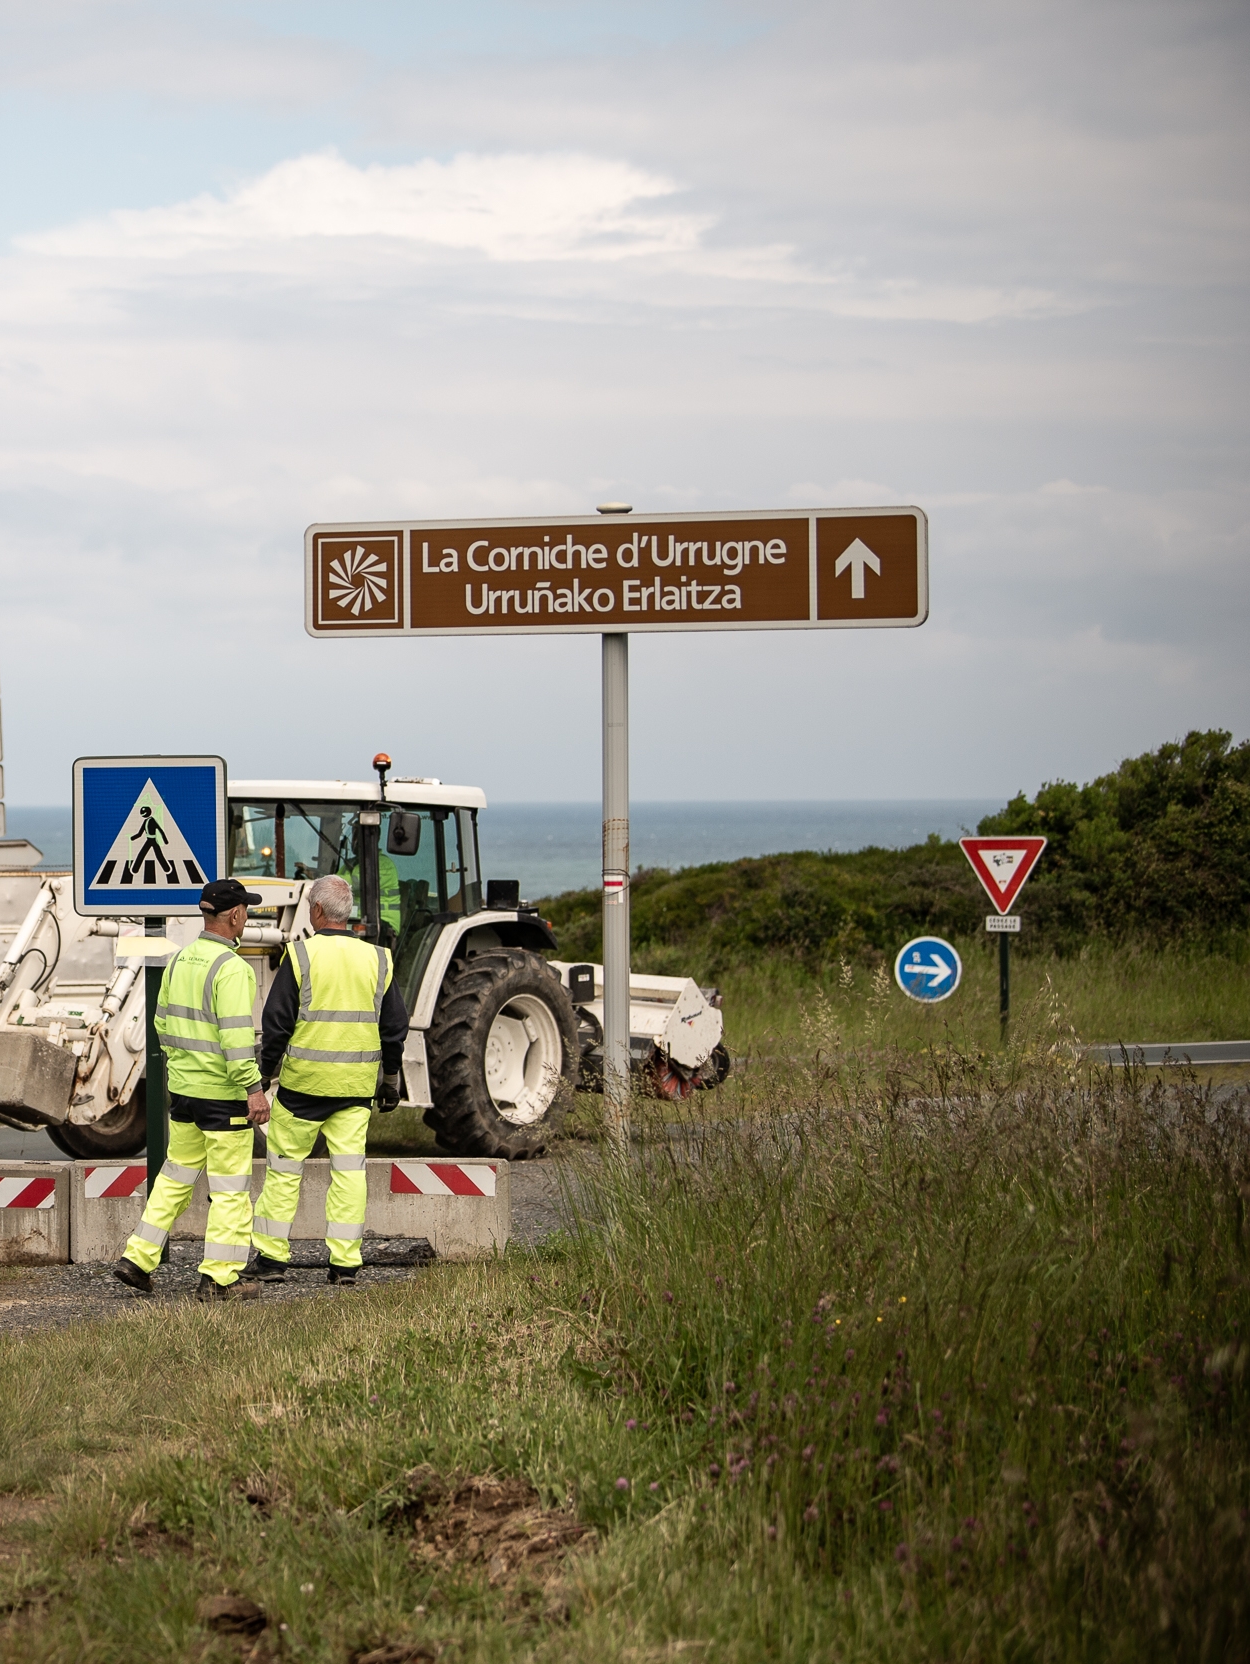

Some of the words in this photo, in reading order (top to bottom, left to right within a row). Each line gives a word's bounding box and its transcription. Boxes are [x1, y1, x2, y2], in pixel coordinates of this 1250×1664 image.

[422, 541, 459, 573] La
[466, 534, 608, 572] Corniche
[616, 532, 787, 576] d'Urrugne
[465, 578, 615, 615] Urruñako
[622, 575, 742, 612] Erlaitza
